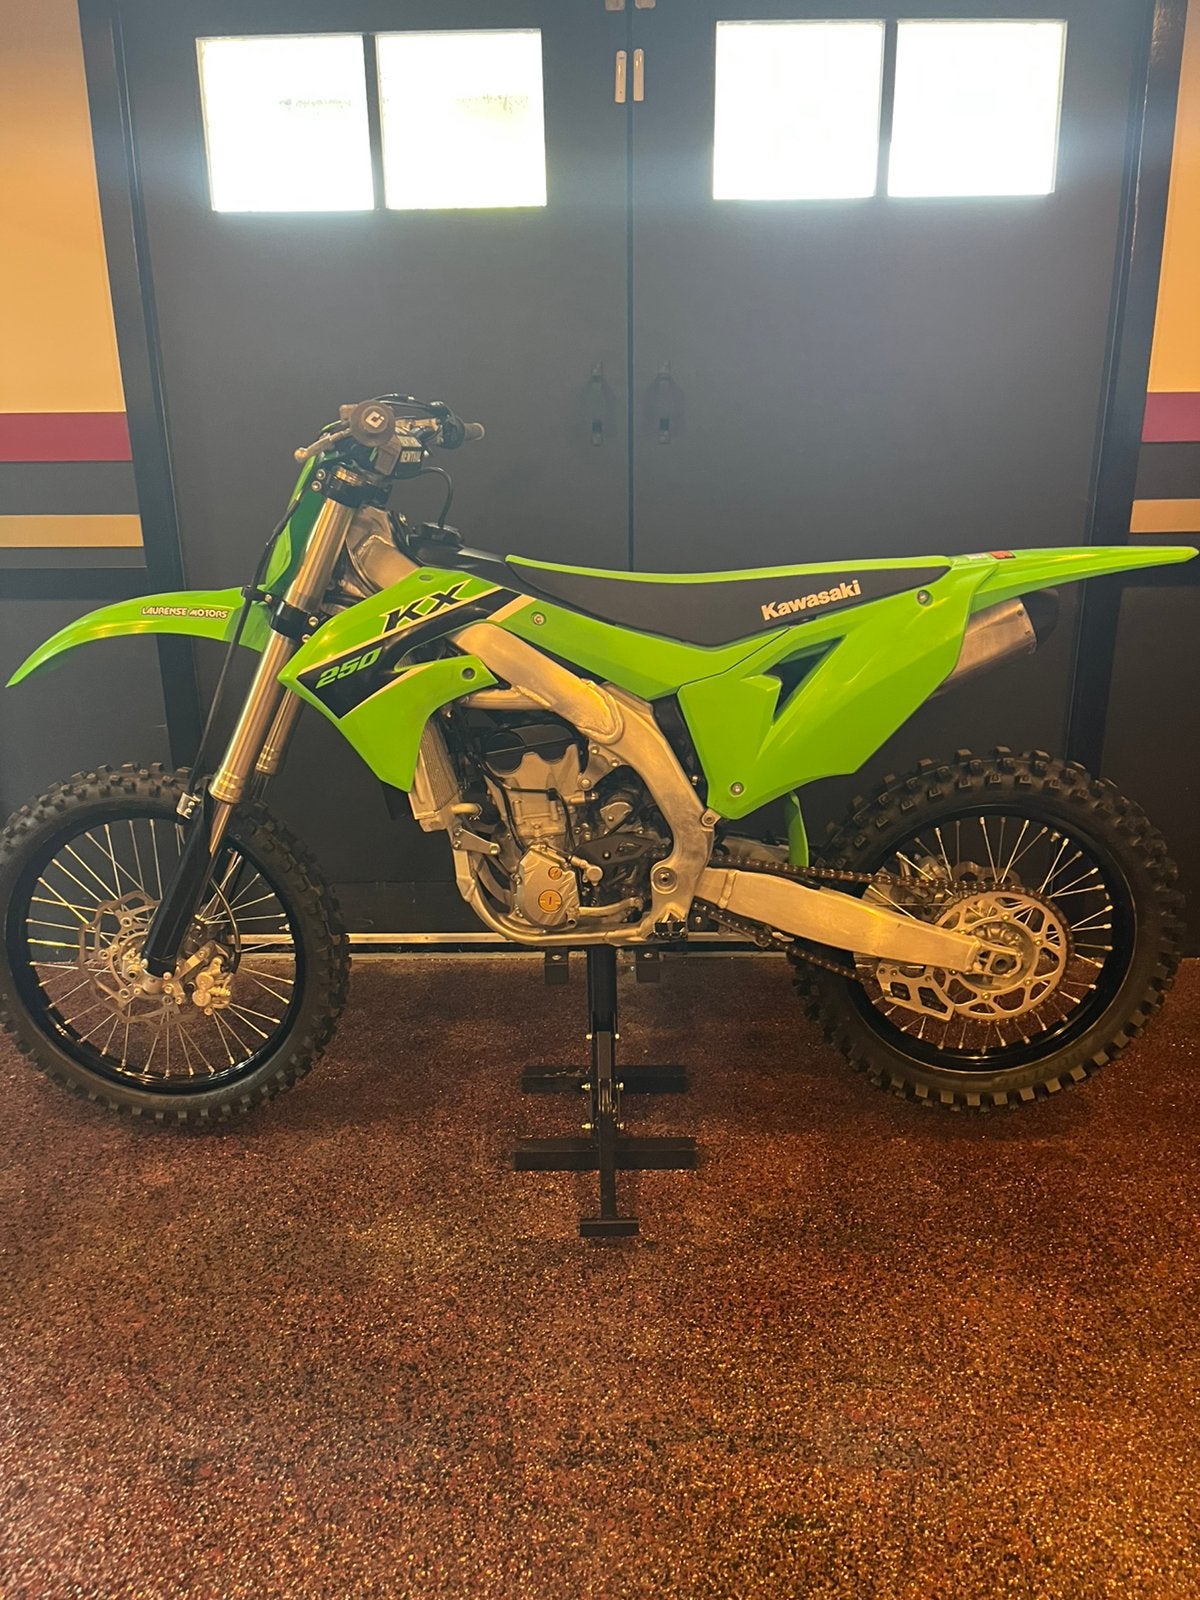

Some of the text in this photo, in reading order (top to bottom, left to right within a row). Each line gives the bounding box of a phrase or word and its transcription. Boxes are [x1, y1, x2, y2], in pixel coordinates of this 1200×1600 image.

[141, 606, 228, 619] LAURENSE MOTORS
[379, 578, 473, 635] KX
[760, 579, 862, 621] Kawasaki
[314, 646, 383, 690] 250
